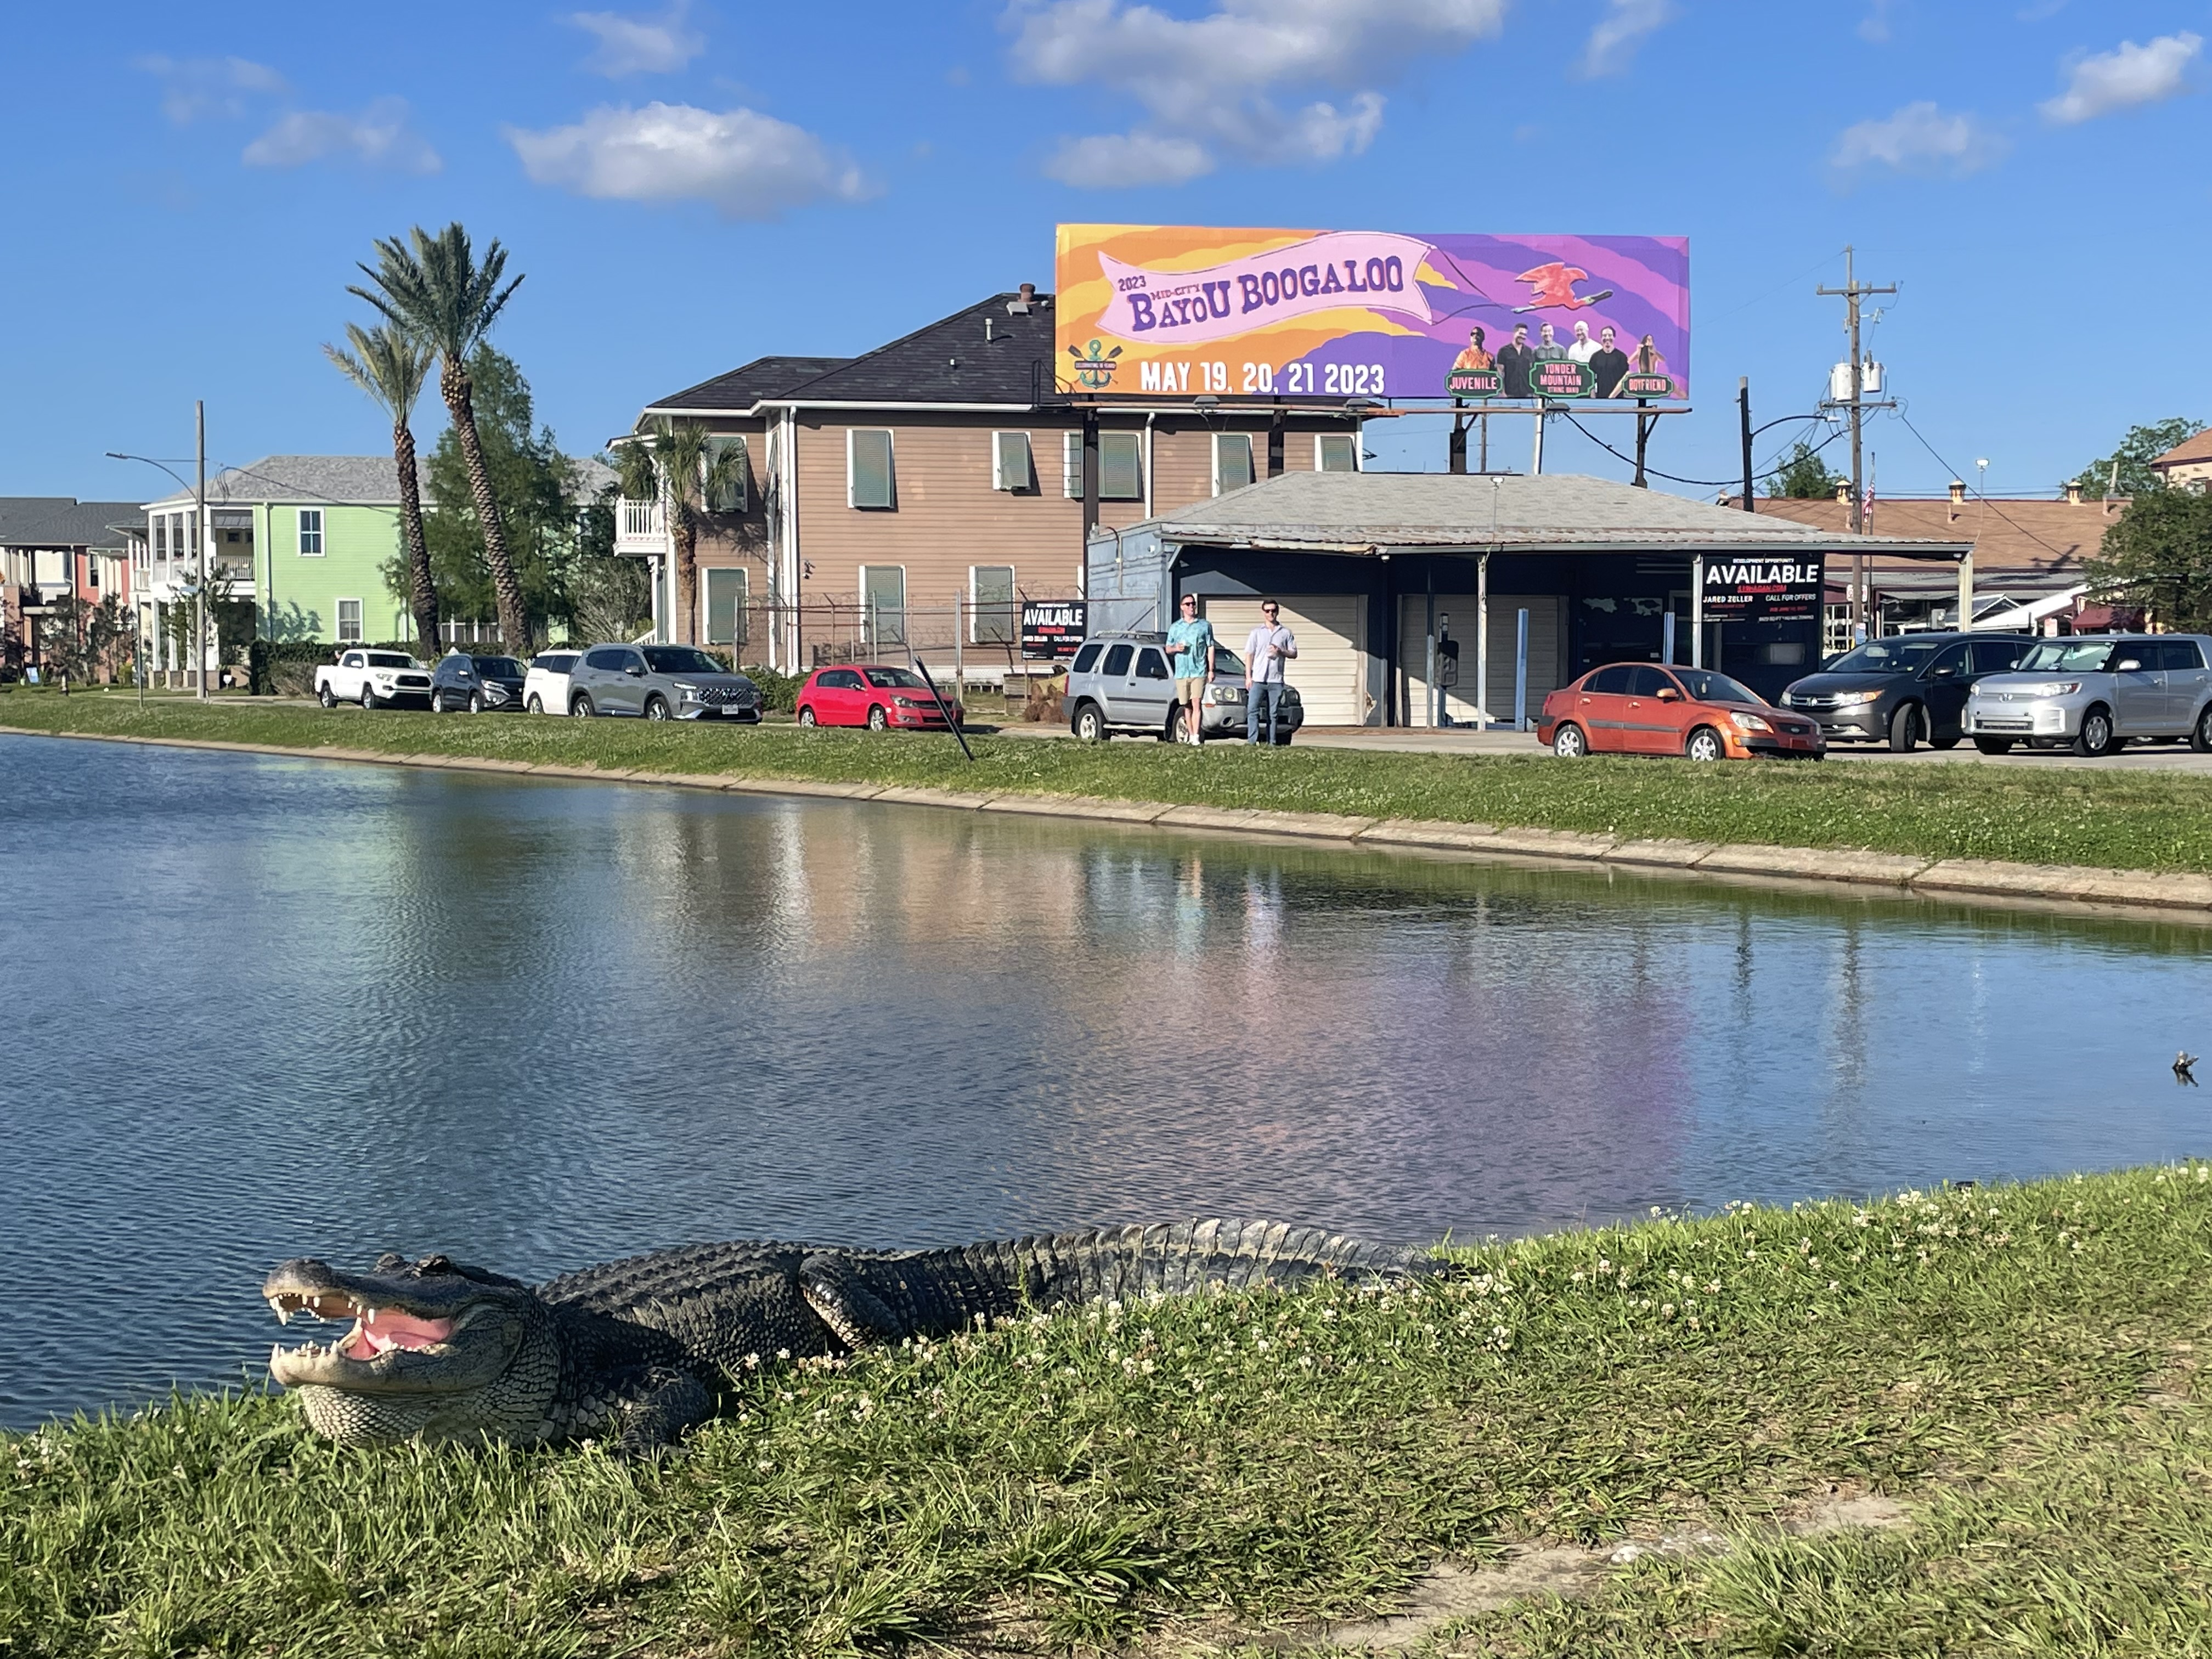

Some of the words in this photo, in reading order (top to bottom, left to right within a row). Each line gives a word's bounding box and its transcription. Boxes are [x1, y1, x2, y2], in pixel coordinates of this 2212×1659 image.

[1118, 275, 1146, 291] 2023
[1127, 280, 1231, 331] BAYOU
[1237, 256, 1403, 314] BOOGALOO
[1150, 284, 1200, 300] MID-CITY
[1545, 364, 1576, 374] YONDER
[1141, 362, 1190, 391] MAY
[1200, 362, 1233, 394] 19,
[1243, 363, 1278, 394] 20,
[1288, 363, 1314, 392] 21
[1324, 364, 1384, 394] 2023
[1449, 376, 1497, 390] JUVENILE
[1540, 375, 1581, 386] MOUNTAIN
[1629, 379, 1666, 391] BOYFRIEND
[1706, 565, 1819, 584] AVAILABLE
[1023, 609, 1084, 625] AVAILABLE
